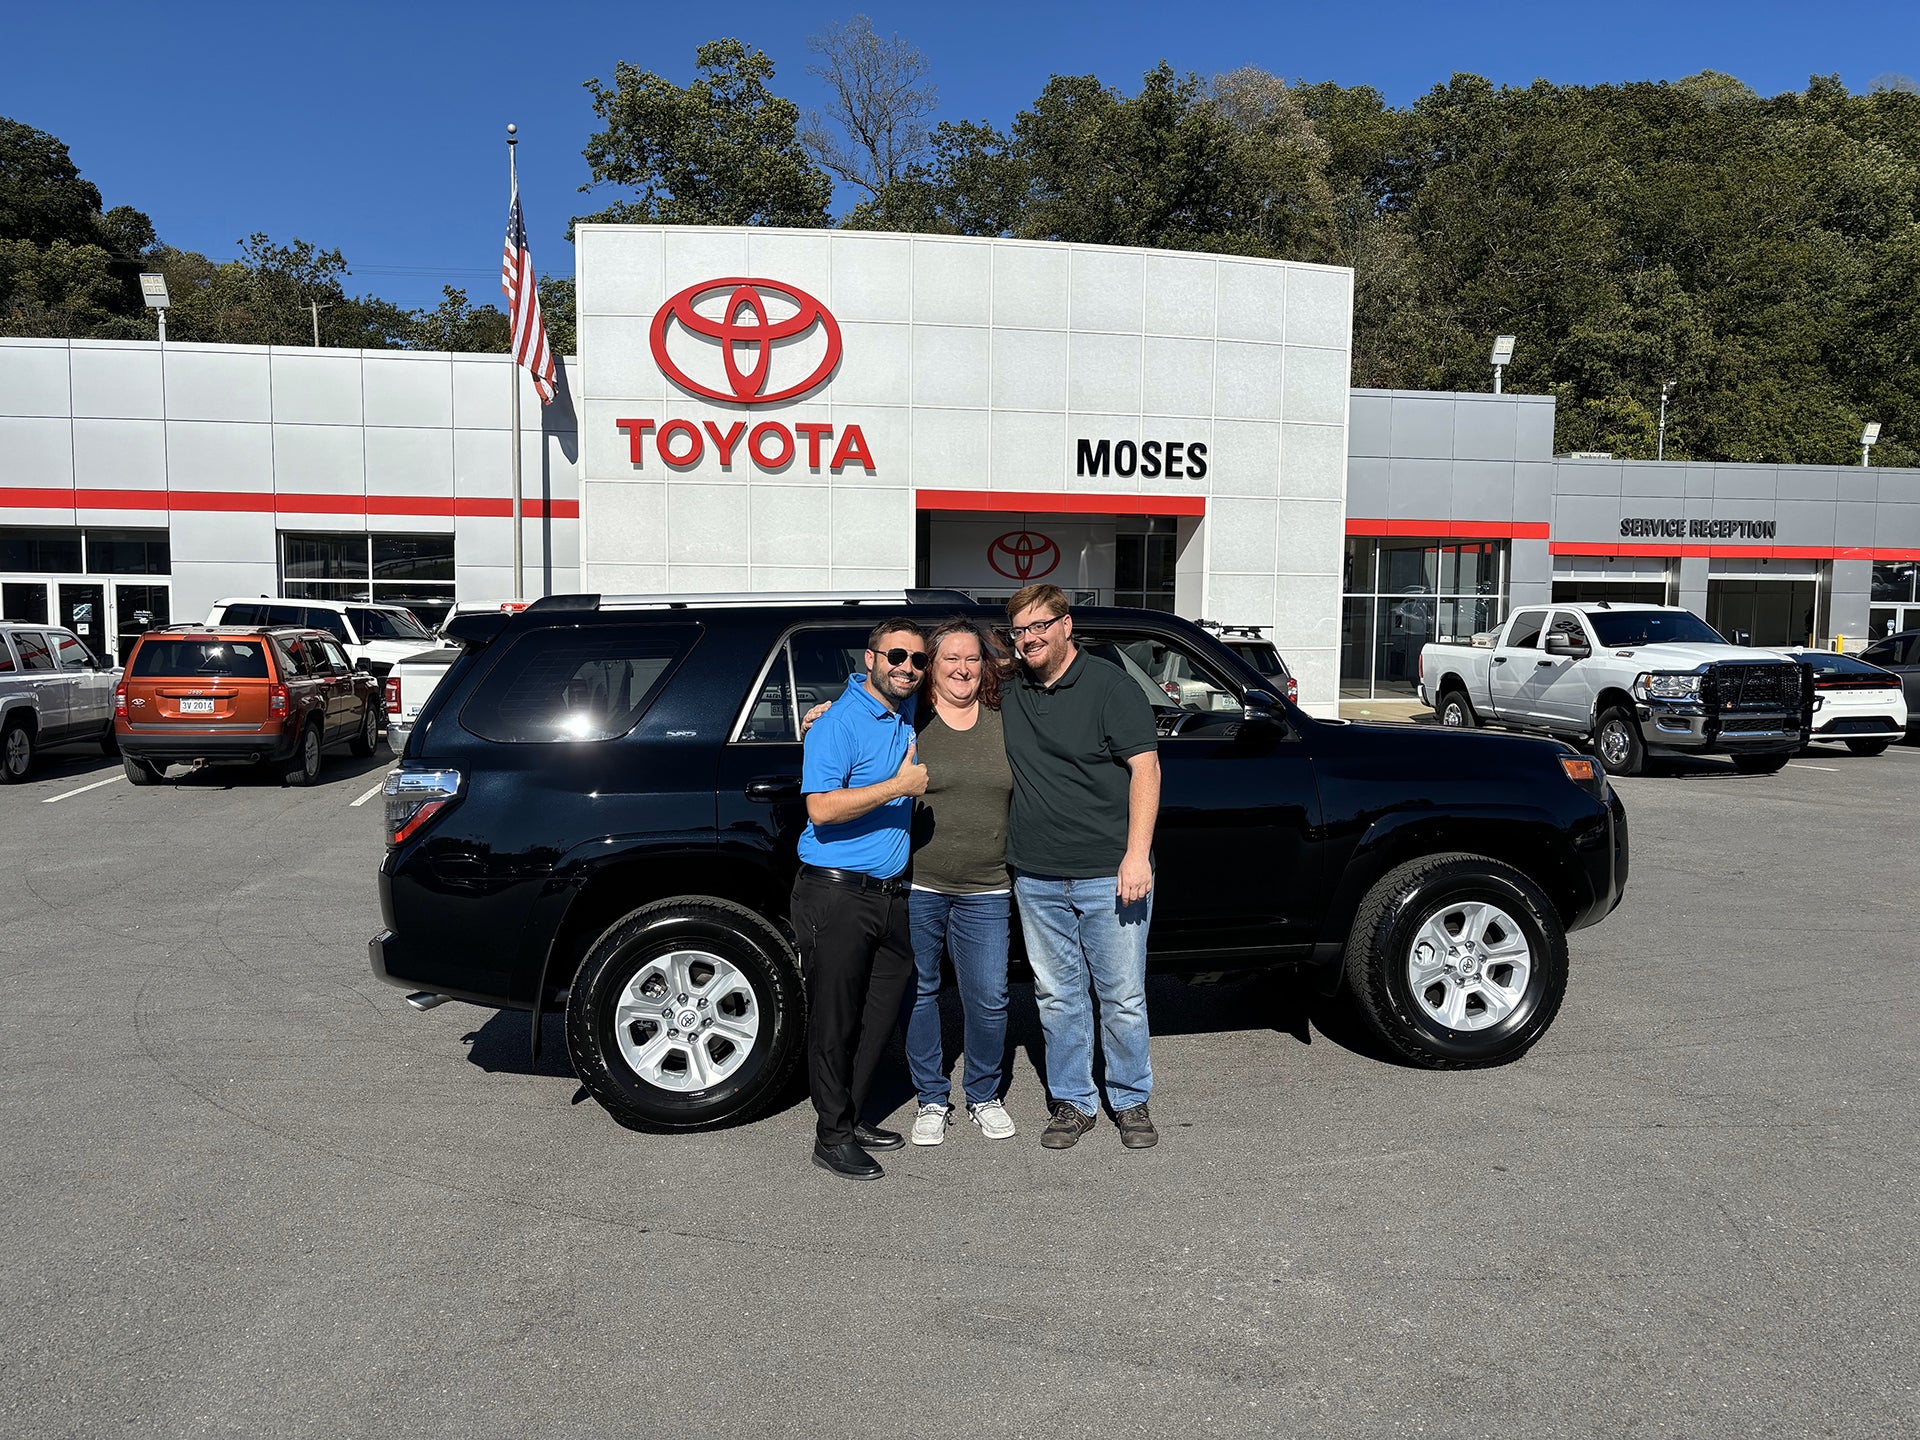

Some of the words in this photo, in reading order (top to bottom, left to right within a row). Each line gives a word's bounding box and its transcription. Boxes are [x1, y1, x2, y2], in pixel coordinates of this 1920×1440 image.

[616, 418, 876, 470] TOYOTA
[1076, 438, 1208, 480] MOSES
[1620, 518, 1687, 538] SERVICE
[1689, 519, 1777, 539] RECEPTION
